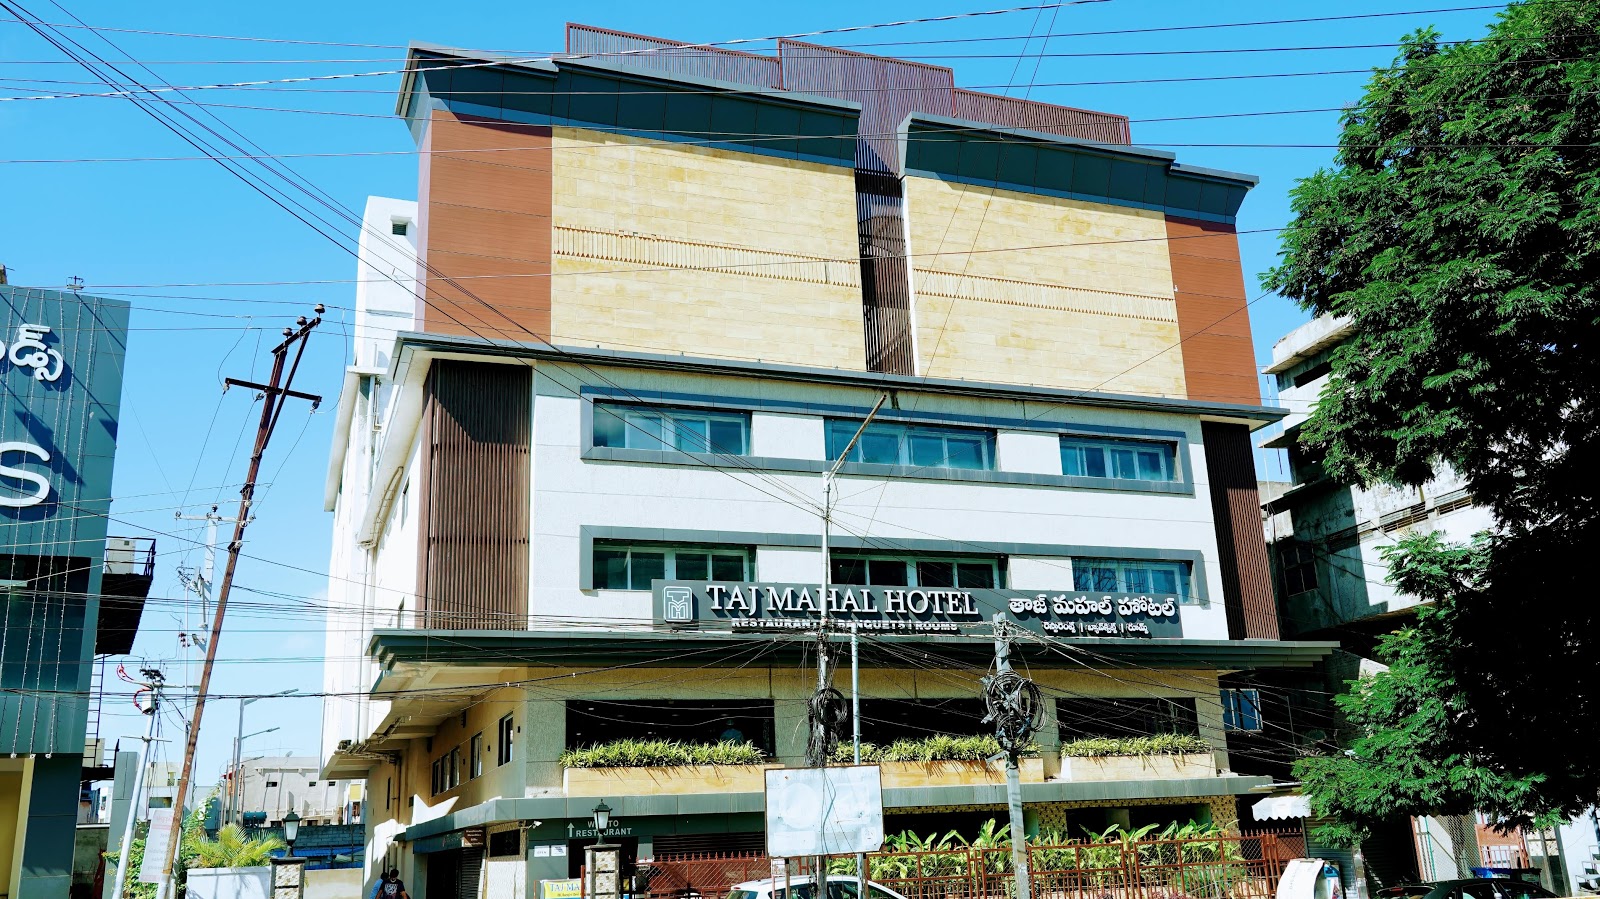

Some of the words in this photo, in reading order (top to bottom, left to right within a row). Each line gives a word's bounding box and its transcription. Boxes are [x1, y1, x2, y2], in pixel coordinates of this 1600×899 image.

[706, 585, 759, 616] TAJ
[766, 586, 878, 613] MAHAL
[884, 589, 979, 615] HOTEL
[1009, 594, 1048, 614] తాజ్
[1053, 594, 1113, 615] మహల్
[1118, 595, 1176, 617] హోటల్
[731, 618, 820, 628] RESTAURANT
[915, 621, 958, 631] ROOMS
[575, 827, 632, 837] RESTURANT
[550, 883, 564, 892] TAJ
